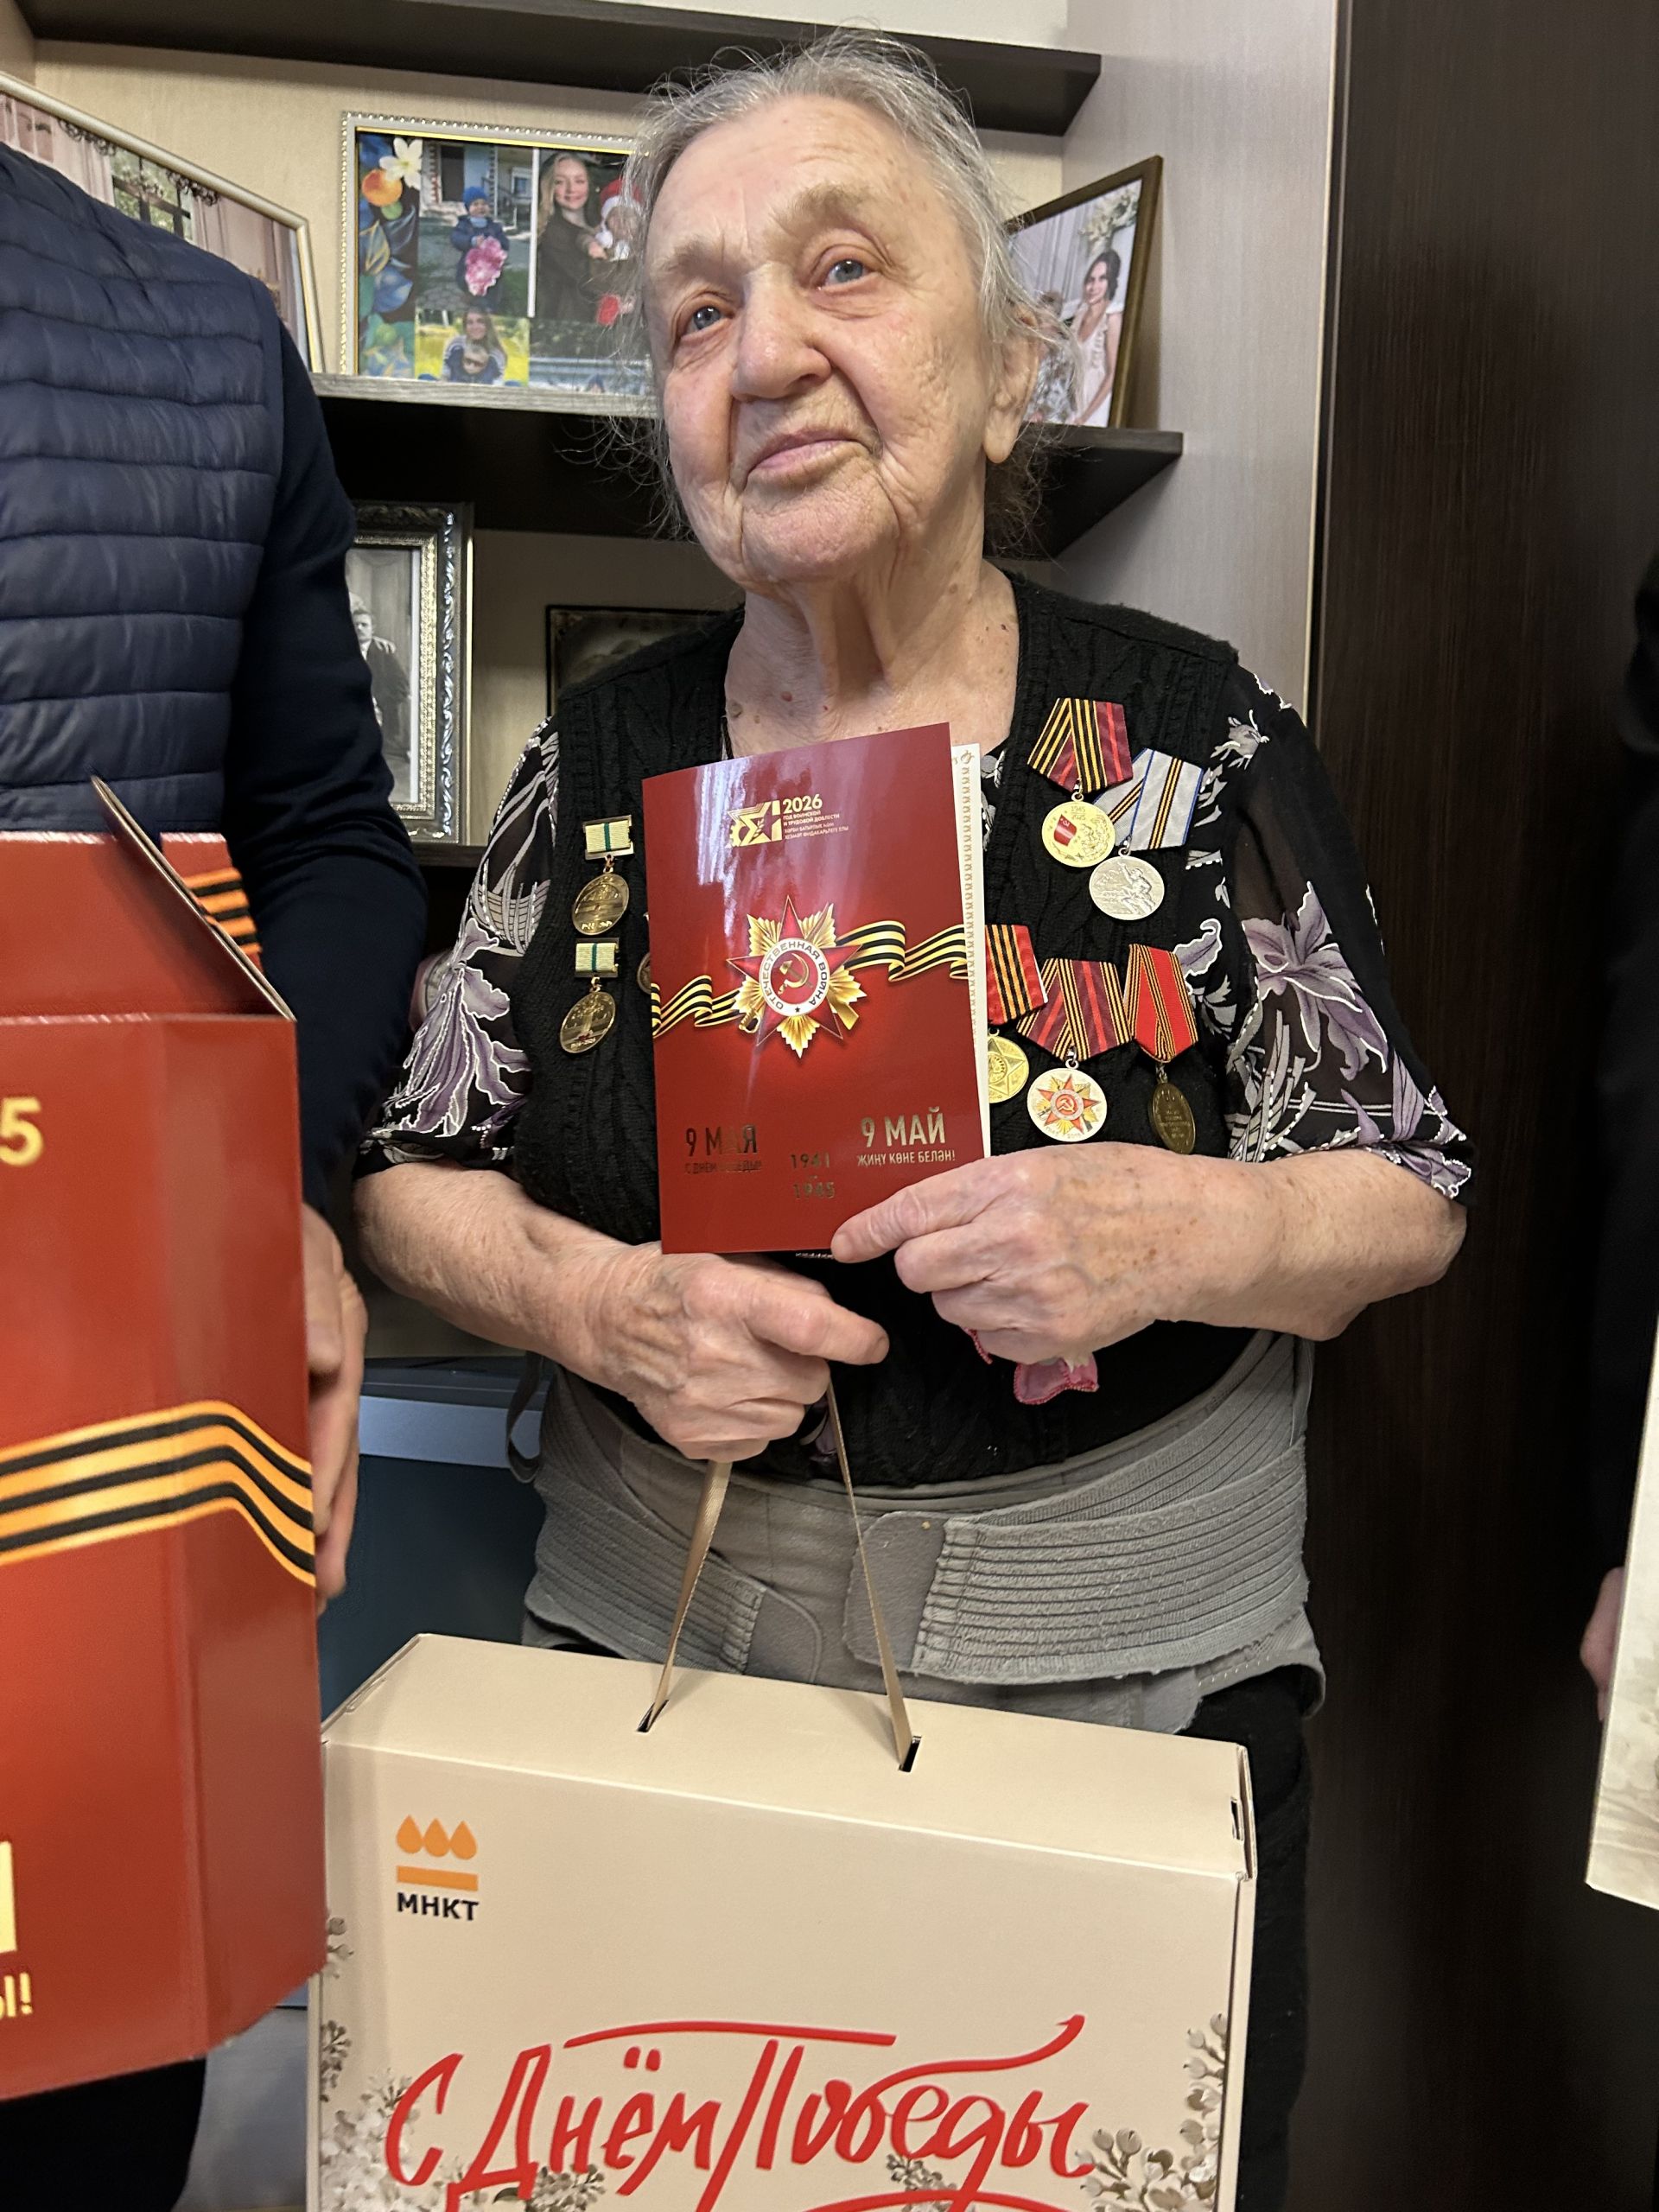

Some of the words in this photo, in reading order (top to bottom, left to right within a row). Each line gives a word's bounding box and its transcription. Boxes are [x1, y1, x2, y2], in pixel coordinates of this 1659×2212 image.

[782, 793, 823, 814] 2026
[814, 813, 840, 823] ДОБЛЕСТИ
[762, 941, 821, 1010] ОТЕЧЕСТВЕННАЯ
[861, 1116, 875, 1148] 9
[884, 1106, 946, 1147] МАЙ
[686, 1128, 696, 1156] 9
[791, 1152, 830, 1169] 1941
[889, 1151, 915, 1165] КӨНЕ
[918, 1149, 956, 1164] БЕЛӘН!
[793, 1181, 835, 1200] 1945
[397, 1891, 480, 1921] МНКТ
[385, 2053, 465, 2186] С
[446, 2044, 721, 2212] Днём
[696, 2014, 1096, 2212] Победы
